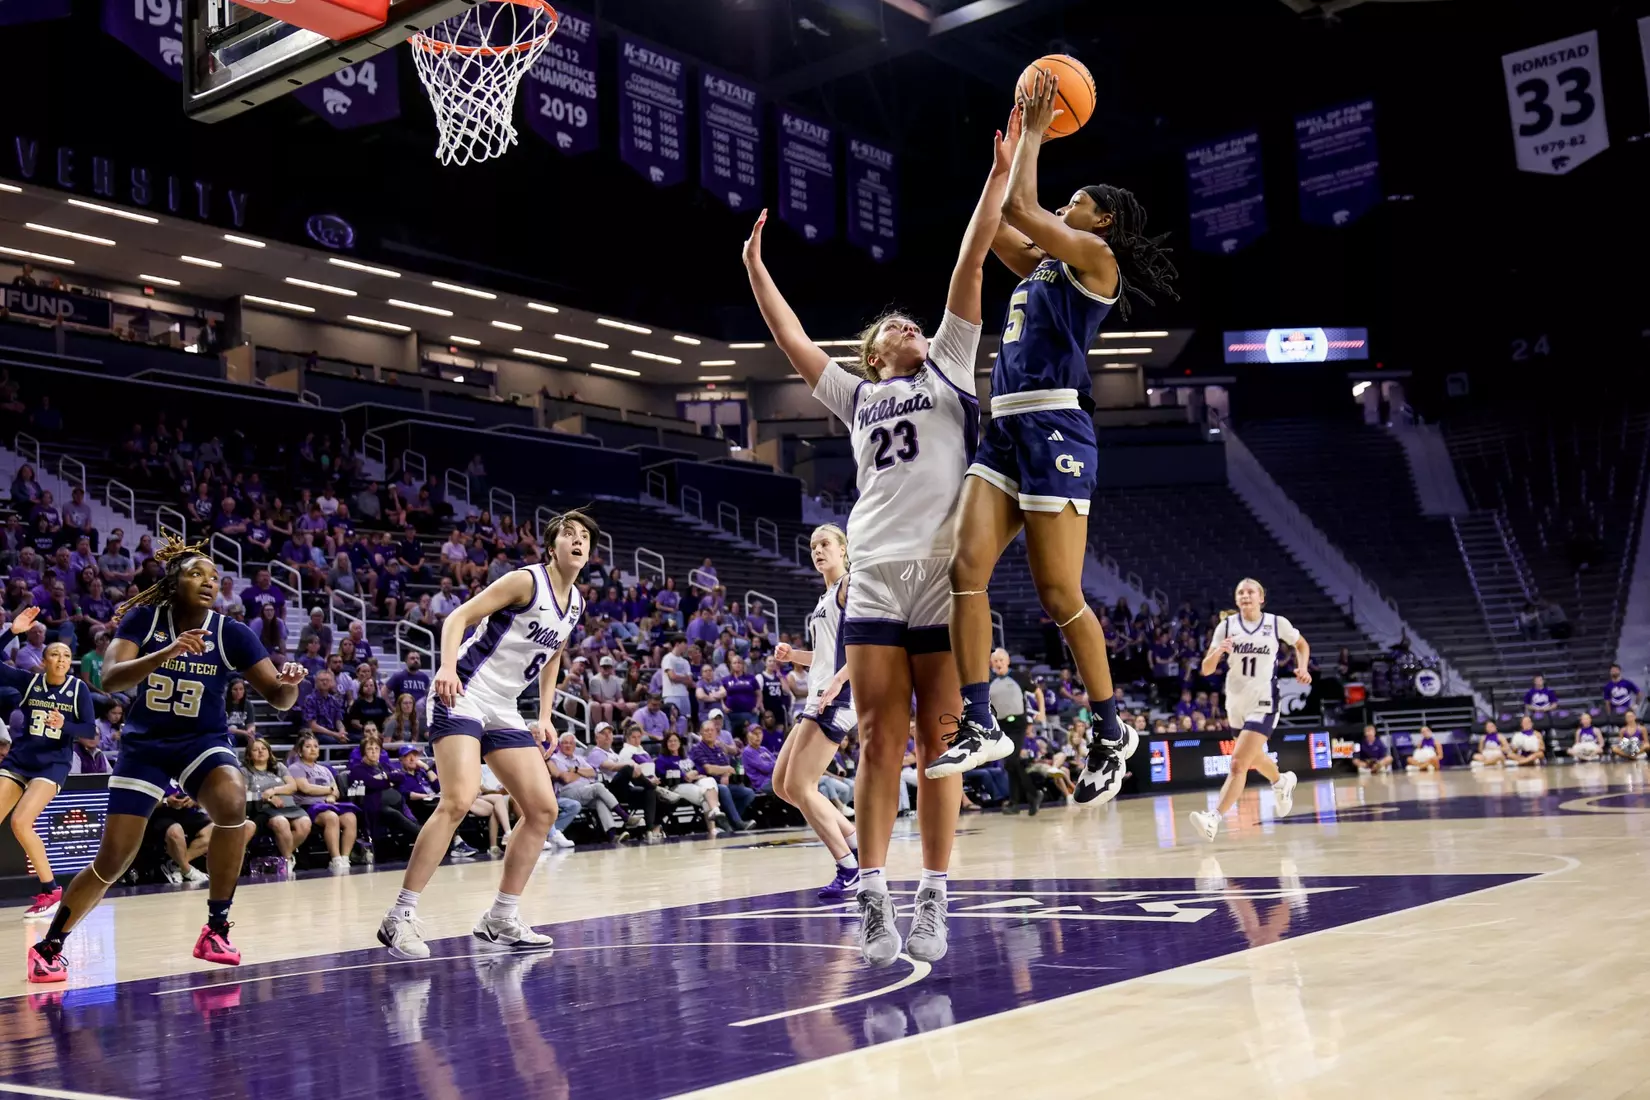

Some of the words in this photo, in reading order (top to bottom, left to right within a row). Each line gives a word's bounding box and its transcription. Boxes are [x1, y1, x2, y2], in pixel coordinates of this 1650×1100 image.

[535, 55, 596, 83] ONFERENCE
[565, 47, 580, 63] 12
[624, 42, 682, 76] K-STATE
[1512, 44, 1589, 76] ROMSTAD
[529, 64, 597, 100] CHAMPIONS
[704, 73, 756, 105] K-STATE
[539, 92, 588, 129] 2019
[1515, 66, 1596, 137] 33
[782, 112, 830, 143] K-STATE
[850, 138, 894, 166] K-STATE
[1533, 134, 1588, 156] 1979-82
[1029, 270, 1059, 284] TECH
[6, 289, 75, 317] FUND
[1002, 290, 1029, 345] 5
[1511, 333, 1551, 362] 24
[858, 393, 933, 430] Wildcats
[870, 419, 919, 471] 23
[1055, 454, 1085, 478] GT
[1232, 642, 1271, 655] Wildcats
[189, 662, 217, 677] TECH
[524, 652, 546, 681] 6
[1241, 656, 1257, 677] 11
[145, 673, 205, 718] 23
[403, 679, 427, 691] STATE
[28, 698, 55, 709] GEORGIA
[56, 703, 73, 713] TECH
